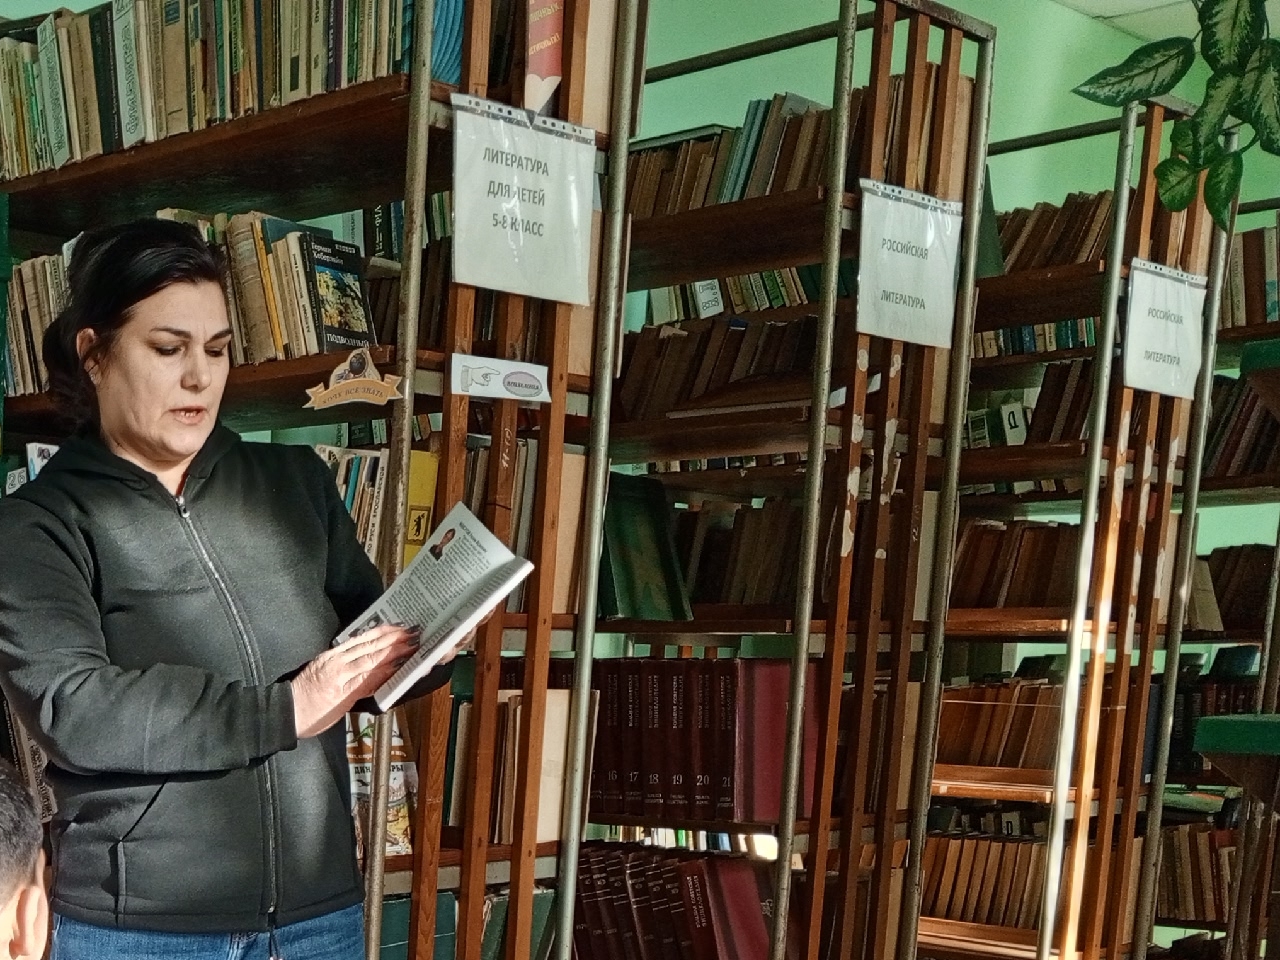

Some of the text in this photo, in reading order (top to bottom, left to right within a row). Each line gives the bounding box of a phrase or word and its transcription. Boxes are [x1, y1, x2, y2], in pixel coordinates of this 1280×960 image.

[483, 147, 549, 176] ЛИТЕРАТУРА
[487, 180, 545, 206] ДЛЯ ДЕТЕЙ
[492, 213, 545, 237] 5-8 КЛАСС
[881, 237, 929, 260] РОССИЙСКАЯ
[880, 289, 926, 310] ЛИТЕРАТУРА
[1147, 306, 1184, 326] РОССИЙСКАЯ
[1143, 350, 1181, 366] ЛИТЕРАТУРА
[629, 771, 639, 782] 17
[649, 773, 659, 785] 18
[672, 774, 683, 785] 19
[696, 774, 710, 786] 20
[722, 776, 731, 787] 21
